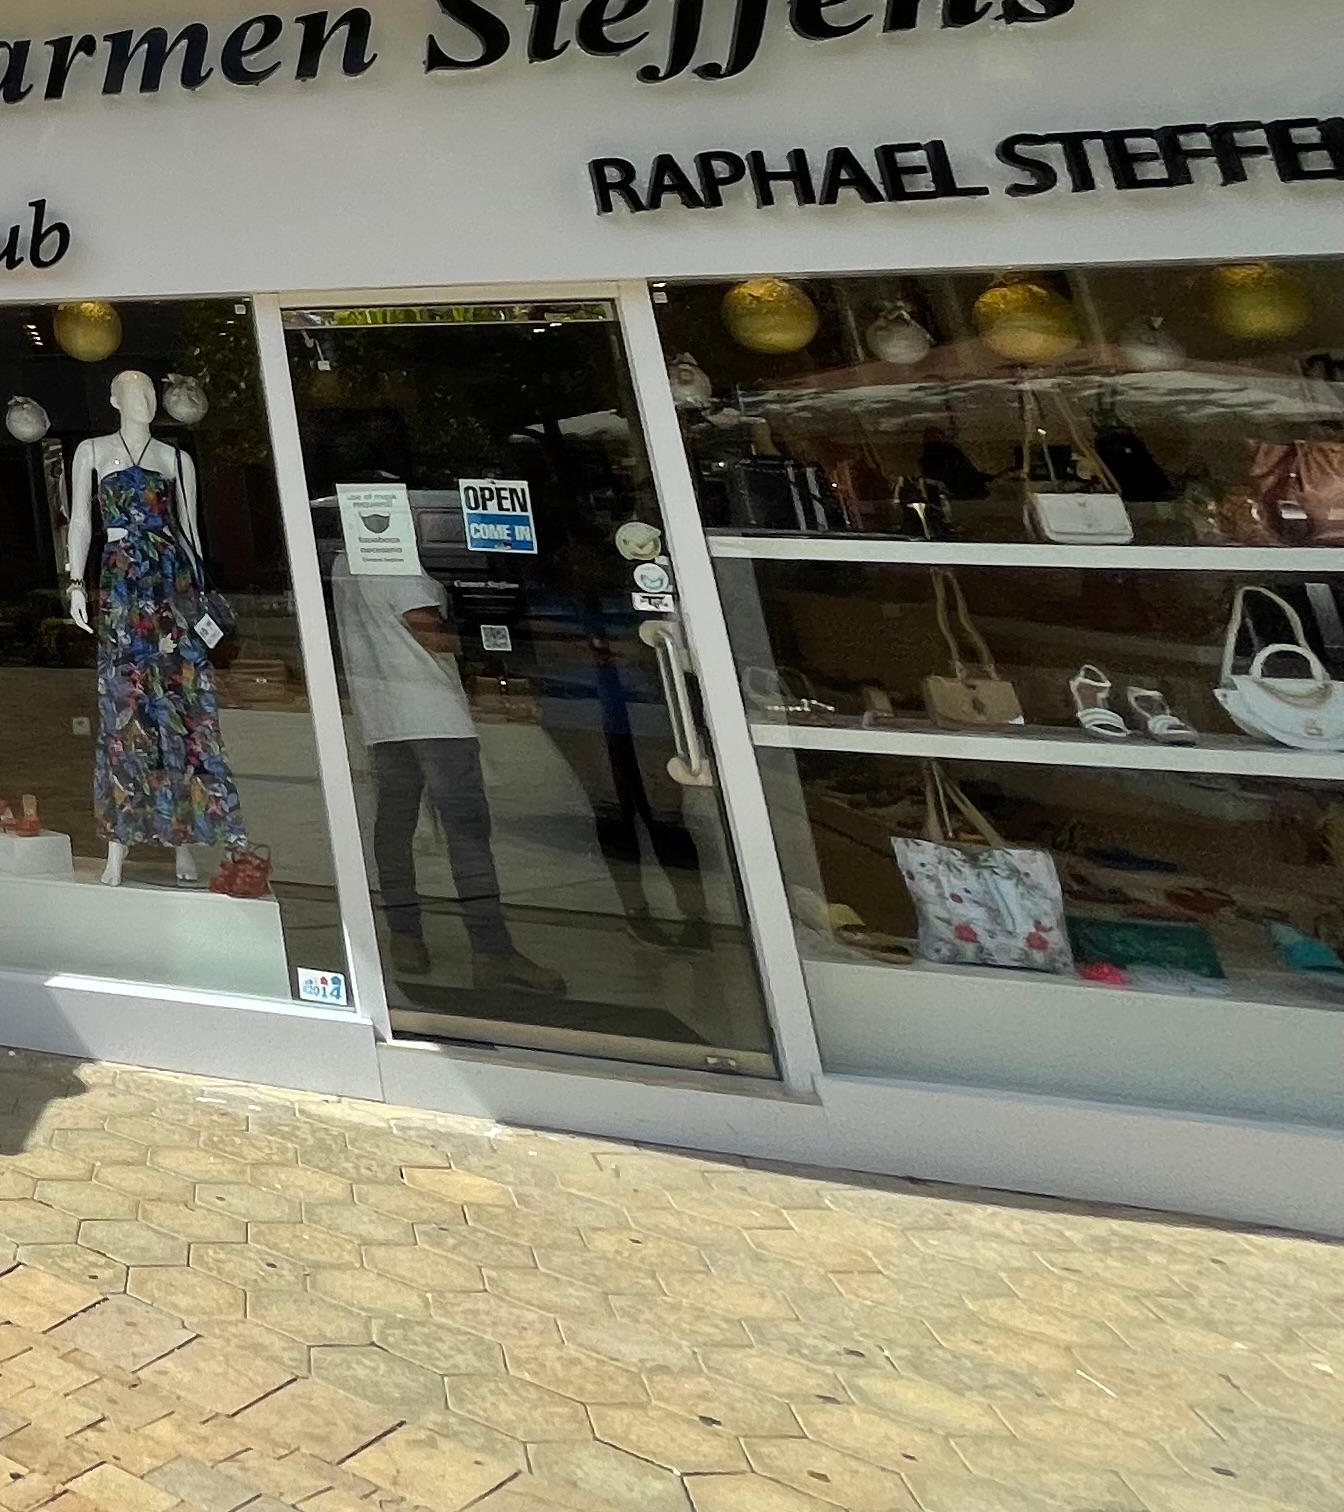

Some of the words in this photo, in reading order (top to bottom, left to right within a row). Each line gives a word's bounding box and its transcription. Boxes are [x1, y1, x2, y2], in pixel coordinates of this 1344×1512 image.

[586, 138, 990, 217] RAPHAEL
[463, 485, 529, 513] OPEN
[469, 522, 512, 540] COME
[514, 525, 532, 541] IN
